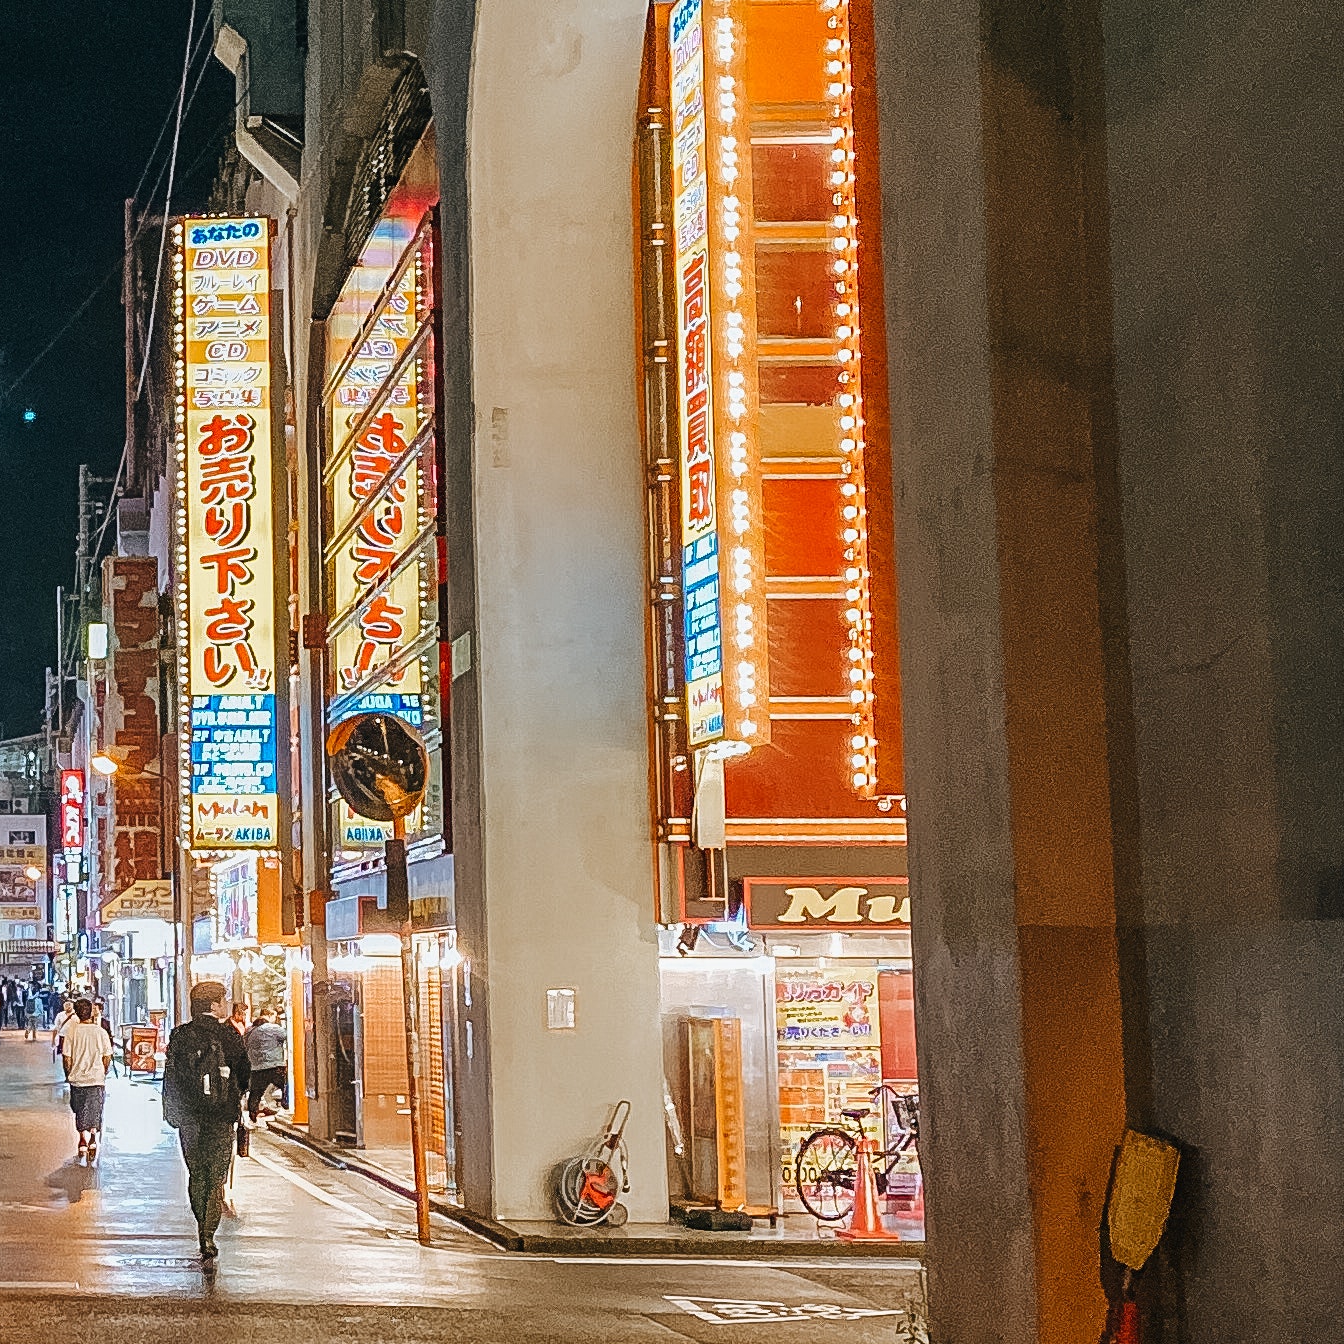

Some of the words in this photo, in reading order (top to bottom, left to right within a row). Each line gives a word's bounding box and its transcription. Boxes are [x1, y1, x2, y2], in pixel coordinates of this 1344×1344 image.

[192, 222, 259, 244] あなたの
[194, 249, 258, 268] DVD
[193, 297, 259, 316] ゲーム
[196, 320, 259, 338] アニメ
[207, 342, 248, 361] CD
[195, 366, 261, 385] コミック
[195, 826, 233, 842] ムーラン
[234, 827, 272, 841] AKIBA
[777, 887, 911, 923] Mu
